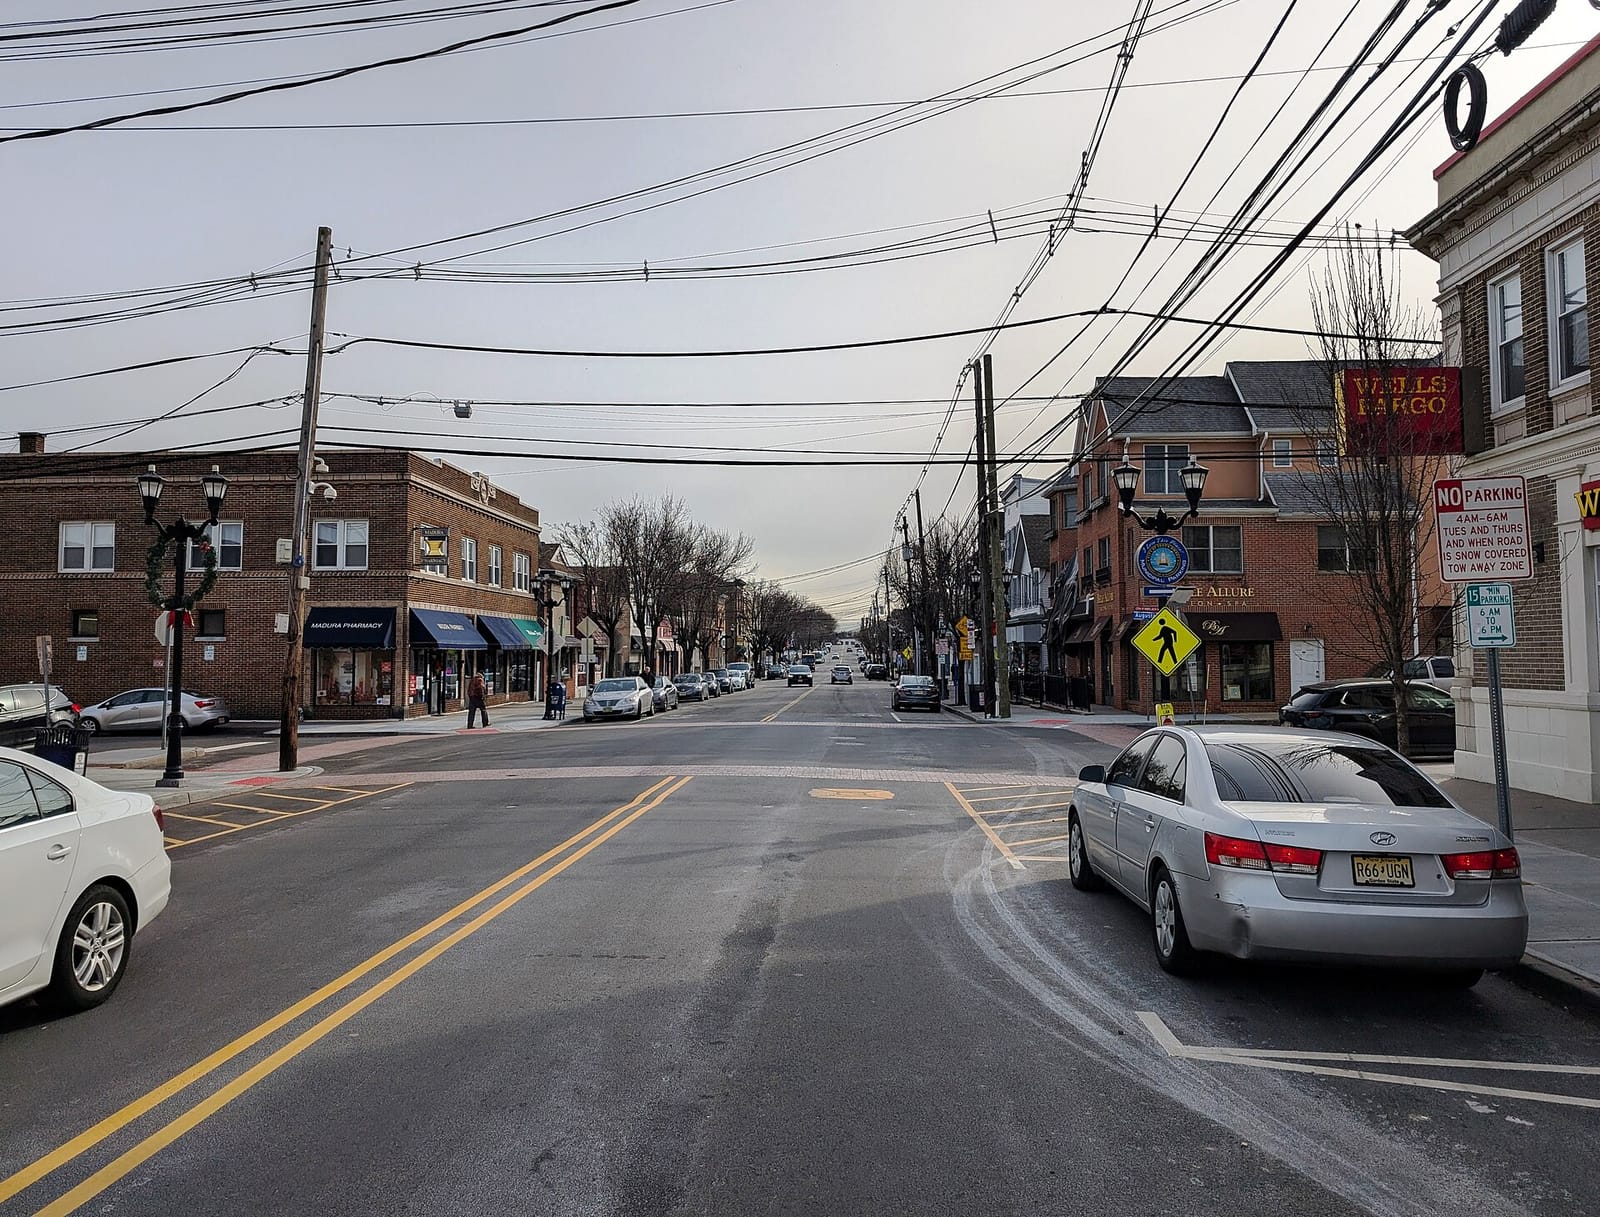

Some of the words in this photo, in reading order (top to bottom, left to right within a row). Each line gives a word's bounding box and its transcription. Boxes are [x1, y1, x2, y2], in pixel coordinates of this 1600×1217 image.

[1437, 487, 1460, 506] NO
[1465, 487, 1522, 502] PARKING
[1443, 526, 1466, 536] TUES
[1470, 525, 1489, 535] AND
[1492, 524, 1523, 533] THURS
[1446, 540, 1464, 549] AND
[1468, 538, 1493, 547] WHEN
[1497, 536, 1523, 546] ROAD
[1443, 552, 1452, 560] IS
[1455, 550, 1480, 560] SNOW
[1484, 548, 1527, 559] COVERED
[1140, 560, 1165, 582] MUNICIPAL
[1448, 564, 1466, 573] TOW
[1470, 562, 1495, 572] AWAY
[1500, 561, 1524, 571] ZONE
[1207, 586, 1255, 597] ALLURE
[1468, 589, 1479, 602] 15
[1481, 595, 1509, 603] PARKING
[1480, 608, 1485, 616] 6
[1489, 608, 1500, 616] AM
[1486, 617, 1496, 625] TO
[1481, 626, 1486, 634] 6
[1490, 625, 1501, 633] PM
